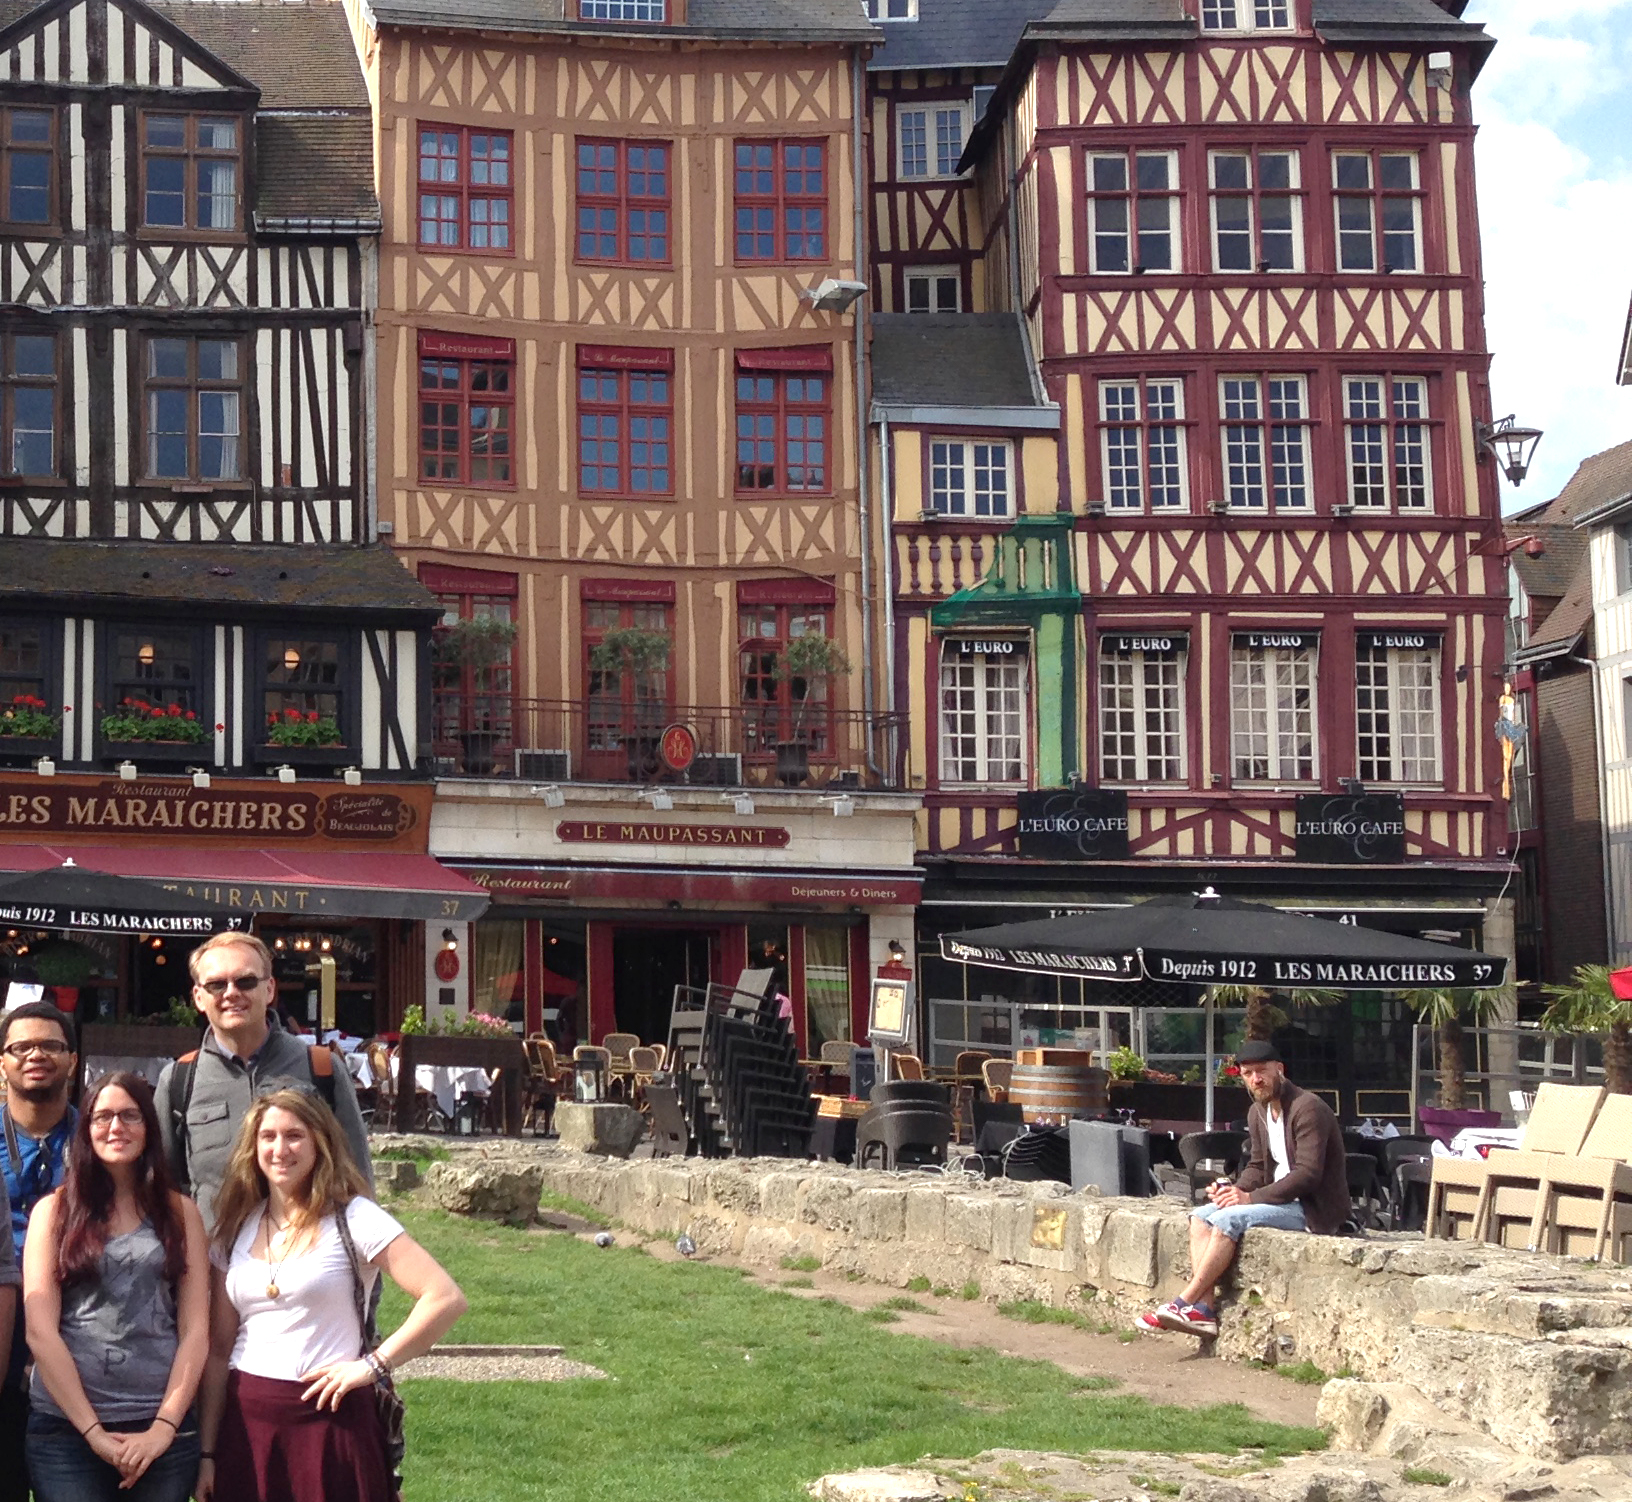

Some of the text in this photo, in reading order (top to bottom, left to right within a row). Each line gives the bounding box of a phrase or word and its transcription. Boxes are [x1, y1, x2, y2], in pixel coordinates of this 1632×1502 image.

[111, 783, 193, 797] Restaurant
[66, 797, 308, 831] MARAICHERS
[1019, 816, 1129, 834] L'EURO CAFE
[1296, 820, 1403, 836] L'EURO CAFE
[582, 824, 767, 845] LE MAUPASSANT
[472, 873, 572, 890] Restaurant
[850, 887, 860, 898] &
[440, 900, 460, 916] 37
[25, 907, 56, 923] 1912
[69, 911, 100, 926] LES
[103, 913, 214, 931] MARAICHERS
[226, 918, 242, 931] 37
[1338, 914, 1358, 927] 41
[1161, 957, 1493, 982] Depuis 1912 LES MARAICHERS 37
